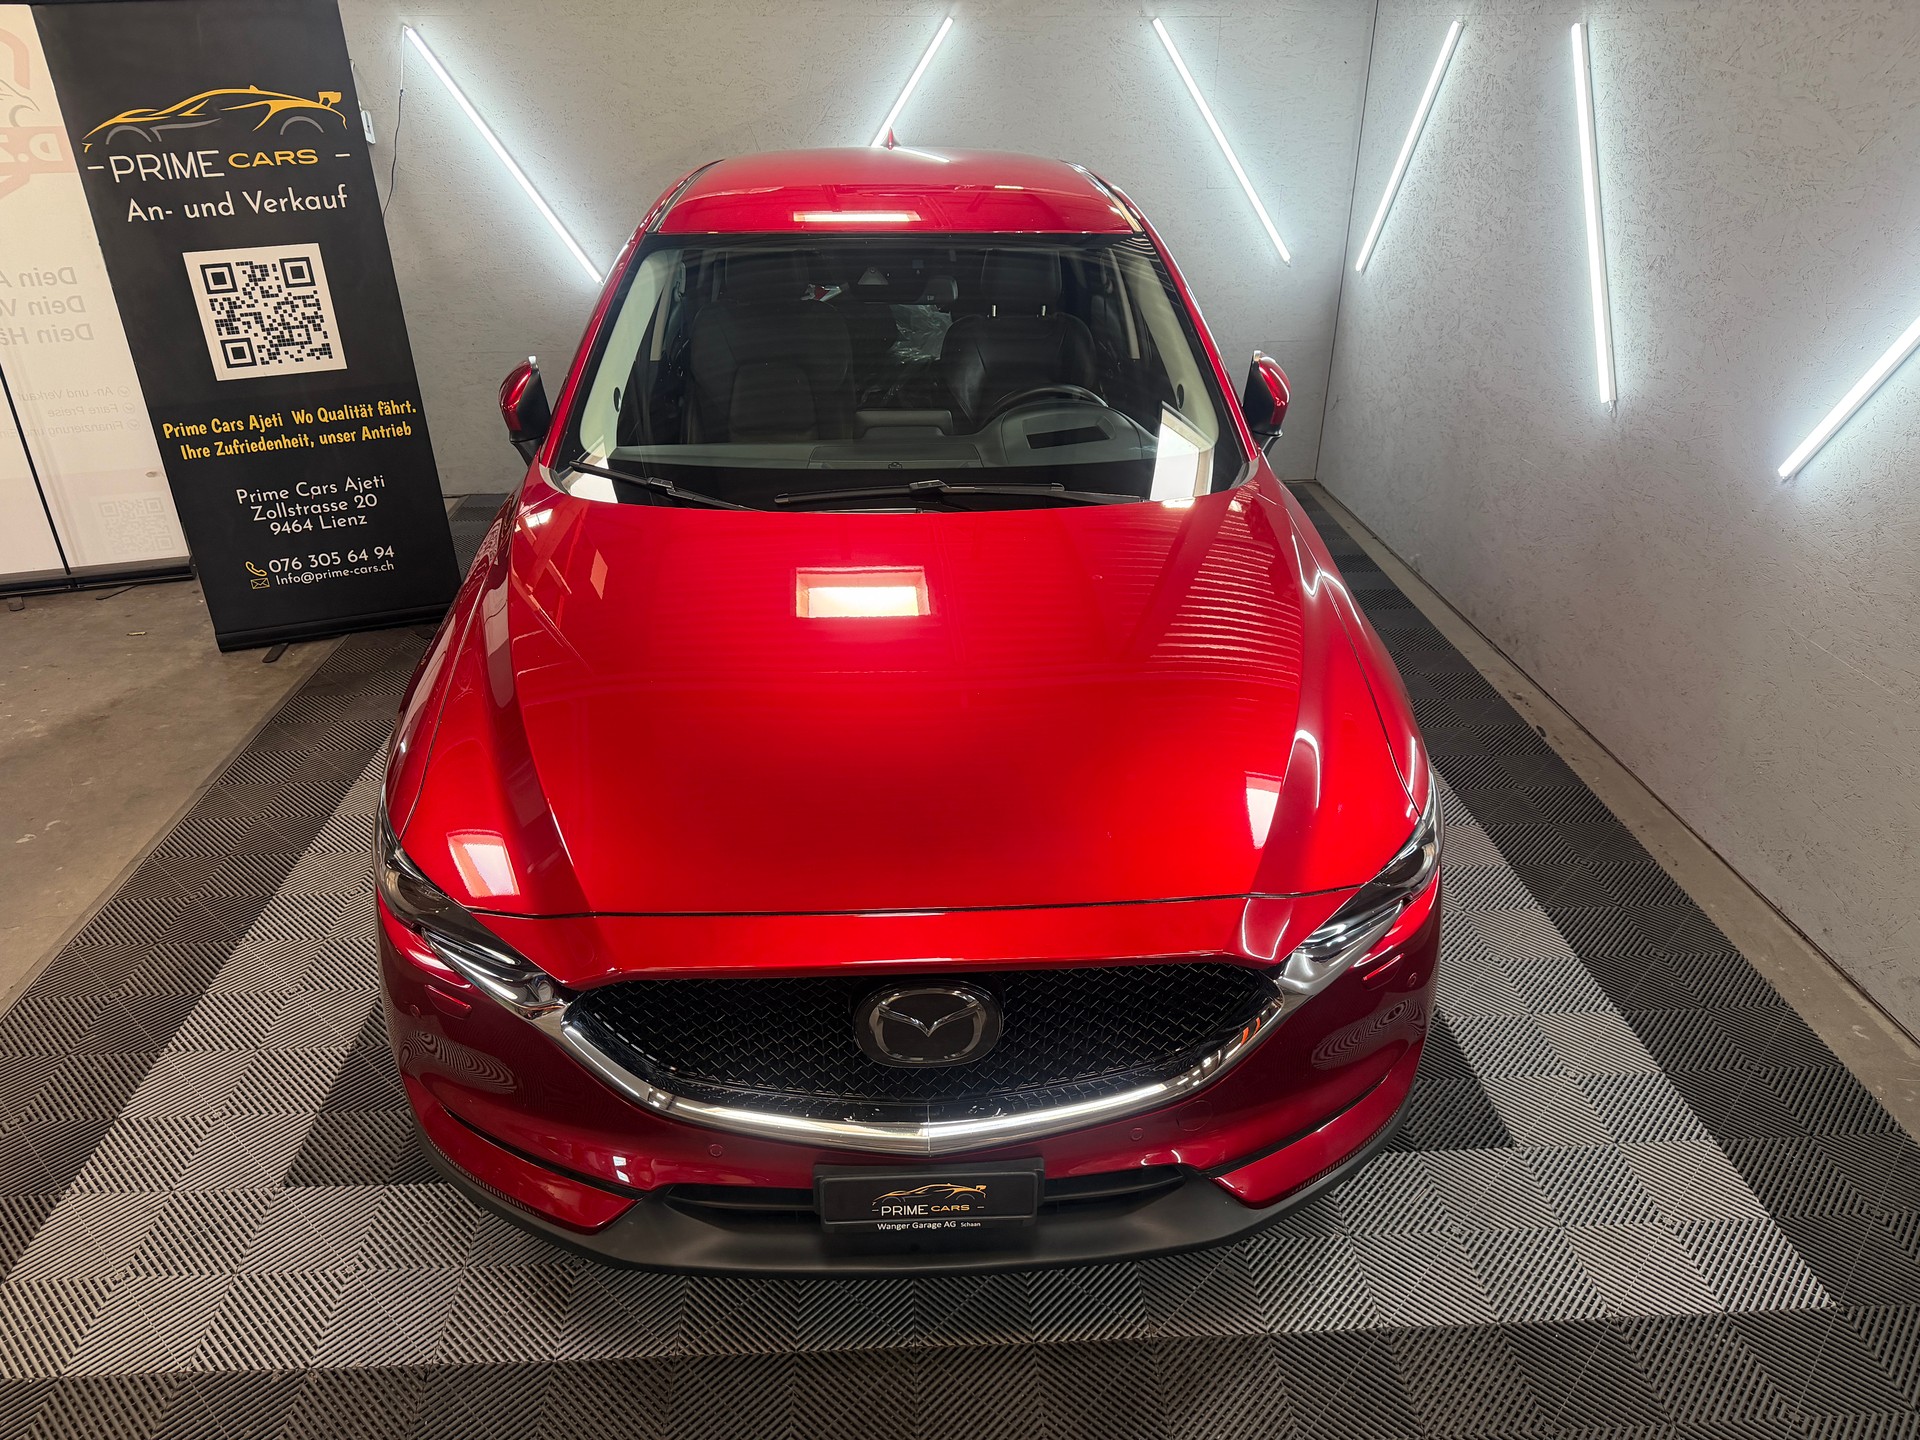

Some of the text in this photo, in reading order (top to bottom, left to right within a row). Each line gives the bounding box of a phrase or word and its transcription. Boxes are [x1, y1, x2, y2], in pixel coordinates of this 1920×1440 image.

[109, 149, 319, 183] PRIME CARS
[127, 183, 348, 222] An- und Verkauf
[162, 399, 417, 439] Prime Cars Ajeti Wo Qualität fährt.
[180, 420, 412, 460] Ihre Zufriedenheit, unser Antrieb
[236, 475, 386, 505] Prime Cars Ajeti
[250, 493, 378, 521] Zollstrasse 20
[269, 514, 368, 536] 9464 Lienz
[268, 545, 395, 573] 076 305 64 94
[275, 560, 395, 586] Info@prime-cars.ch
[881, 1204, 970, 1216] PRIME CARS
[877, 1223, 910, 1231] Wanger
[912, 1221, 942, 1230] Garage
[944, 1220, 957, 1228] AG
